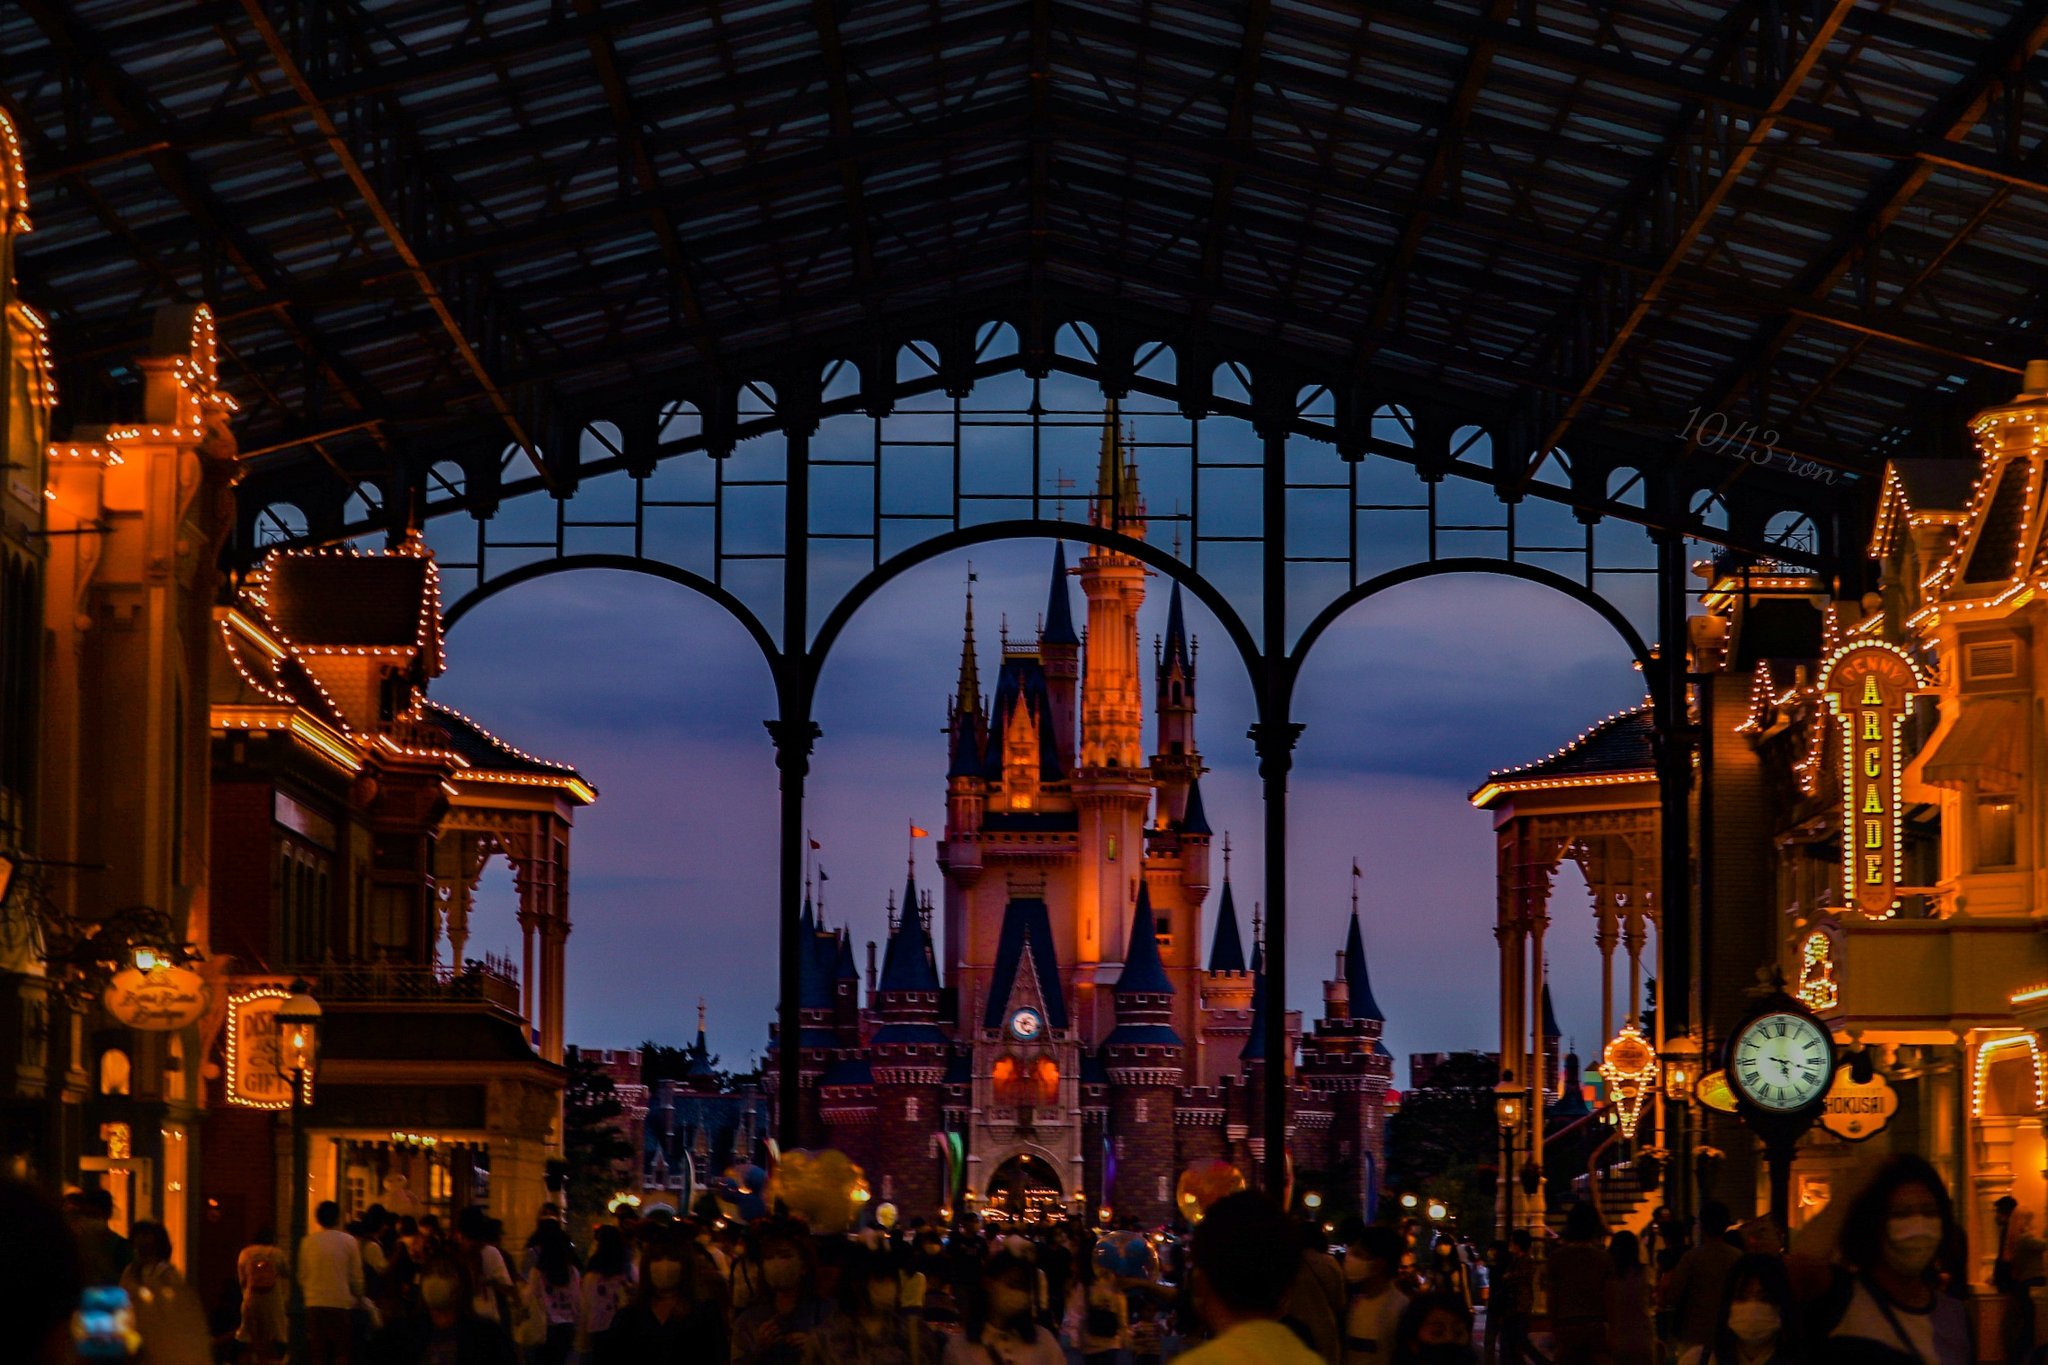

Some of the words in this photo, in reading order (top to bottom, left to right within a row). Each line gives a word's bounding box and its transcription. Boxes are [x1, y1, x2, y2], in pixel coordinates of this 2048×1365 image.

[1841, 656, 1903, 681] PENNY
[1861, 675, 1884, 885] ARCADE
[1824, 1096, 1885, 1114] HOKUSAI
